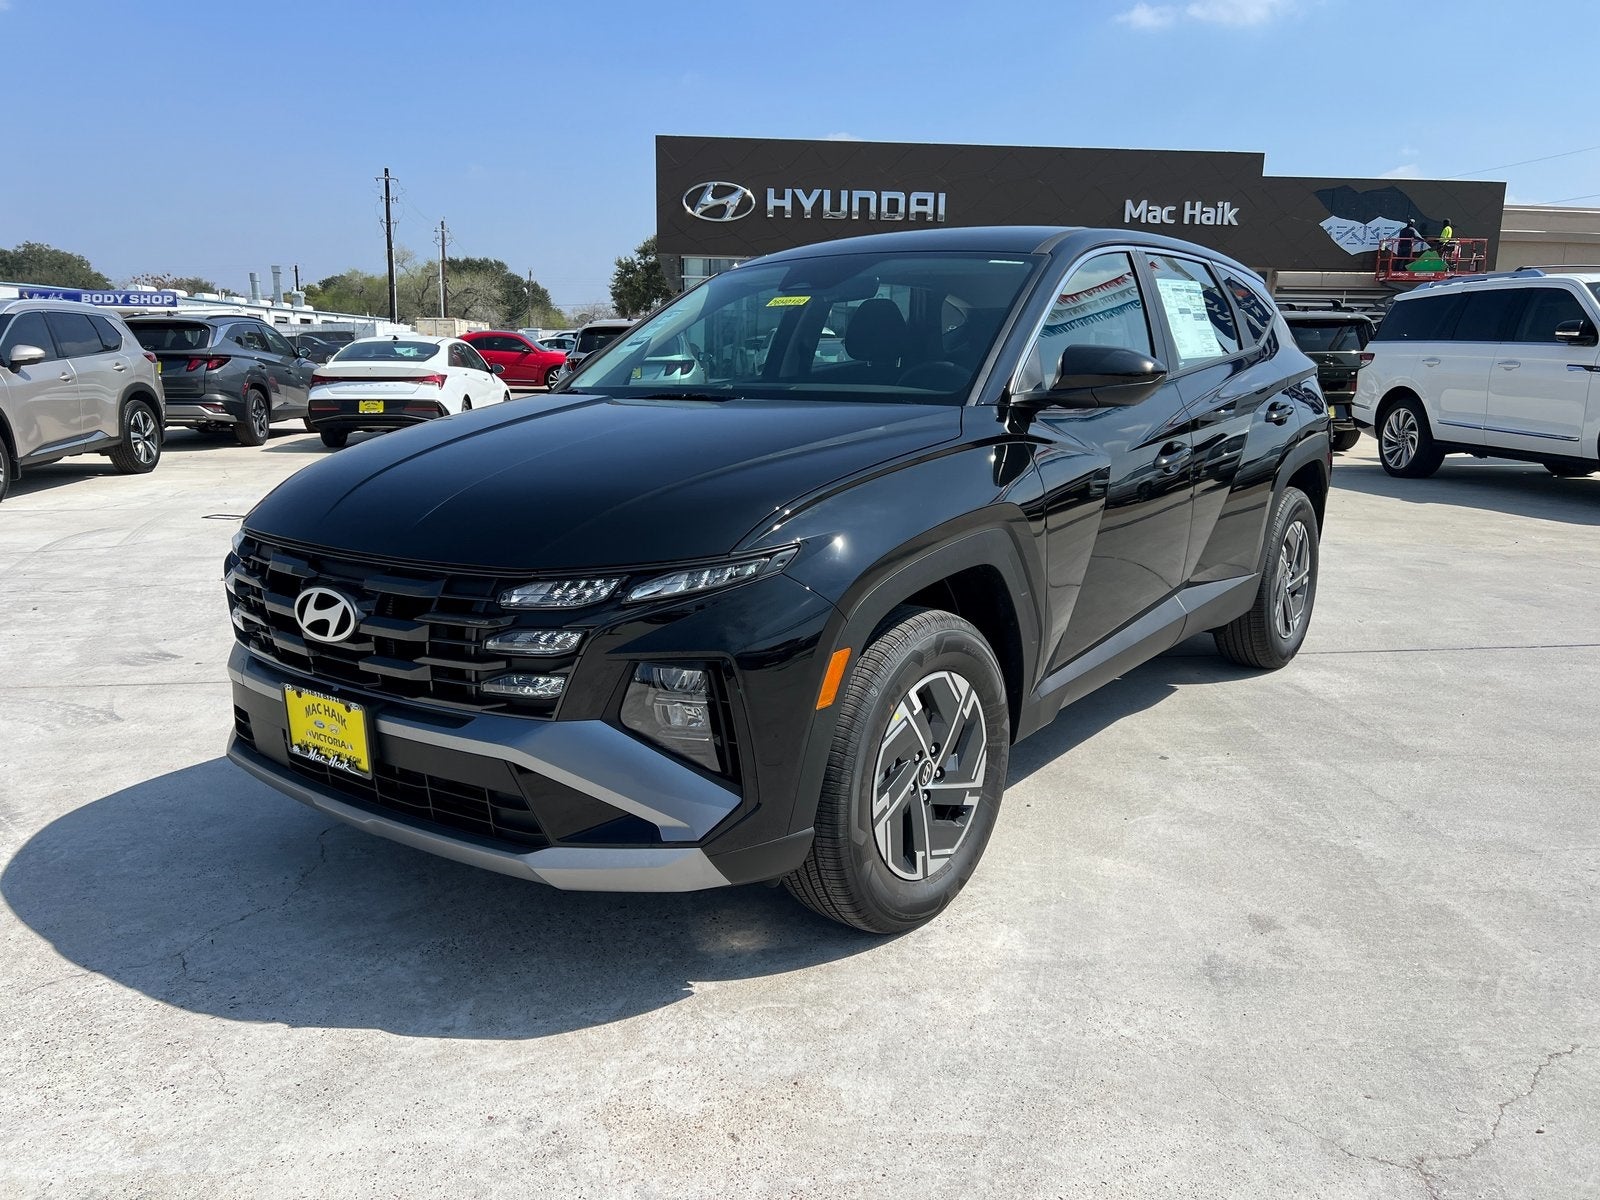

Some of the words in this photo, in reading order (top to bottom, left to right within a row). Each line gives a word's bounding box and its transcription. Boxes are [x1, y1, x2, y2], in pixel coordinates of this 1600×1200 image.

[767, 187, 946, 222] HYUNDAI
[1124, 199, 1176, 224] Mac
[1183, 201, 1240, 226] Haik
[81, 293, 126, 304] BODY
[128, 294, 174, 305] SHOP
[305, 703, 322, 718] MAC
[323, 704, 347, 730] HAIK
[310, 730, 348, 750] VICTORIA
[308, 748, 326, 763] Mac
[329, 755, 350, 770] Haik
